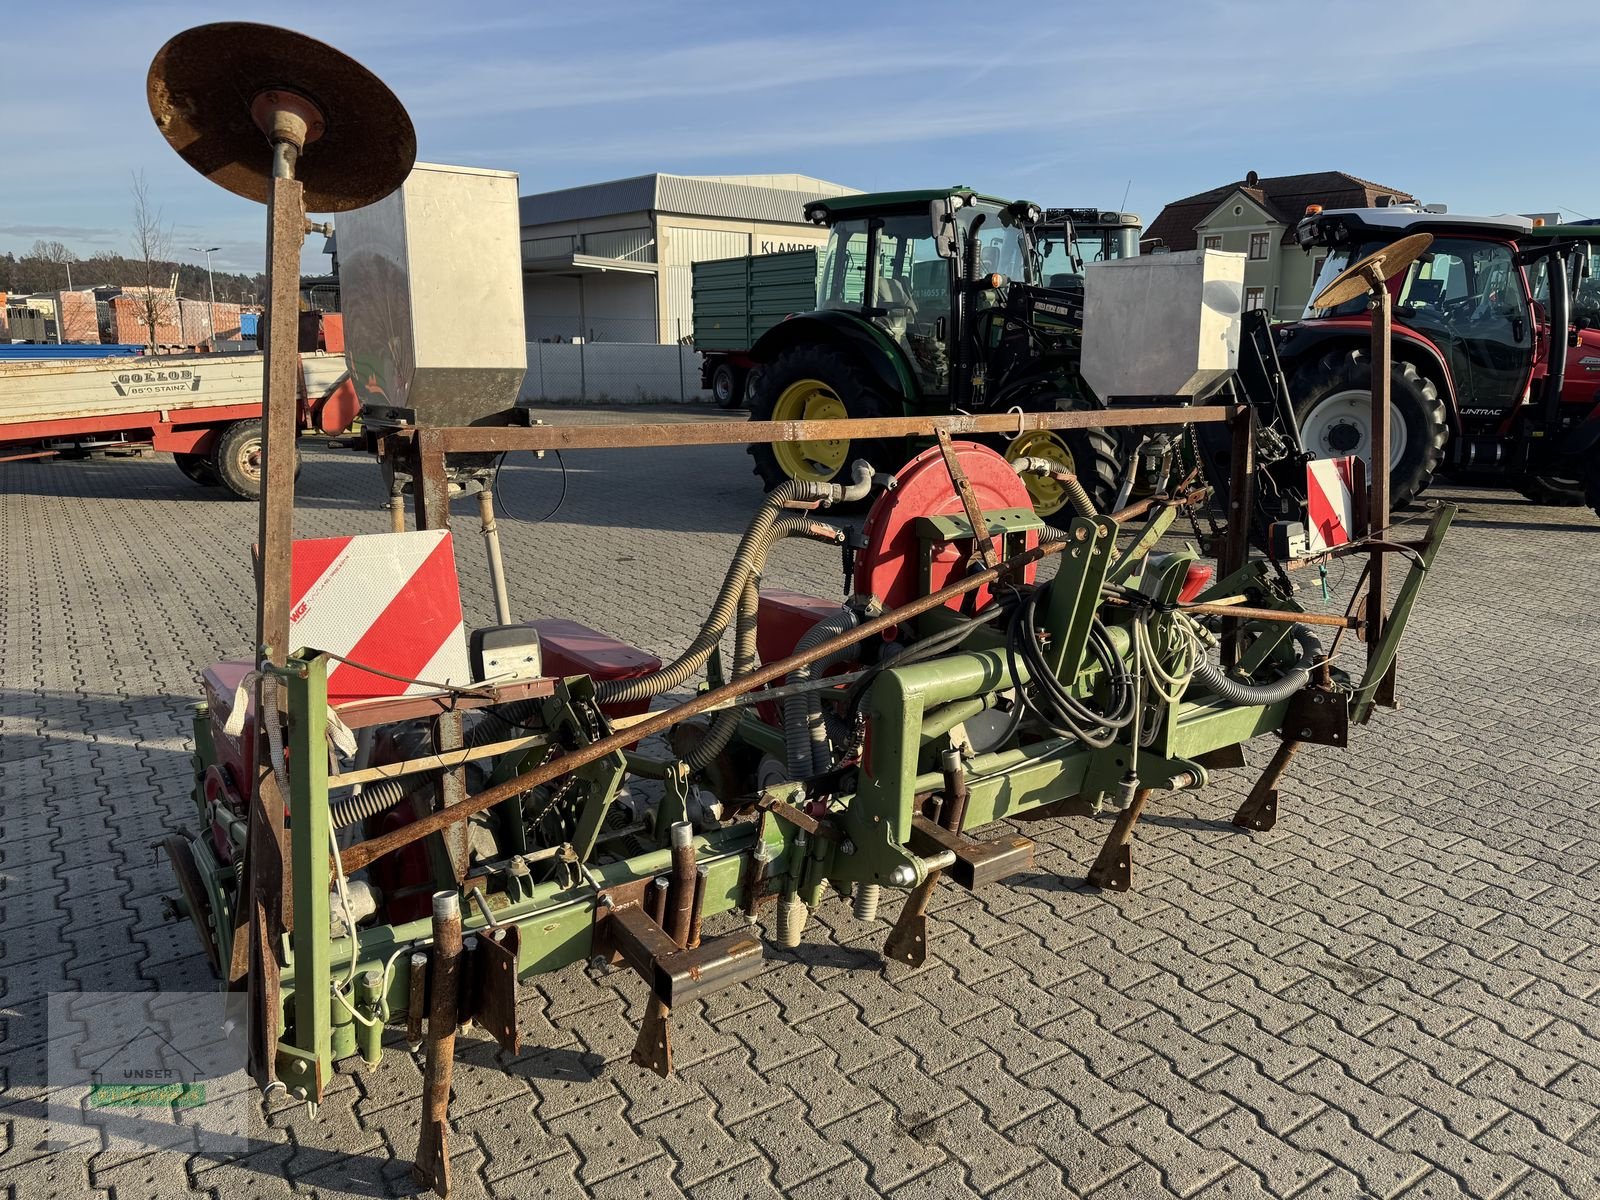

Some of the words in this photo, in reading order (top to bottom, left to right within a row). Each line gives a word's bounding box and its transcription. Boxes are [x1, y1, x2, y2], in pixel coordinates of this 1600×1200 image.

[761, 240, 816, 254] KLAMP
[118, 370, 193, 384] GOLLOB
[154, 384, 186, 393] STAINZ
[1460, 408, 1502, 416] LINTRAC
